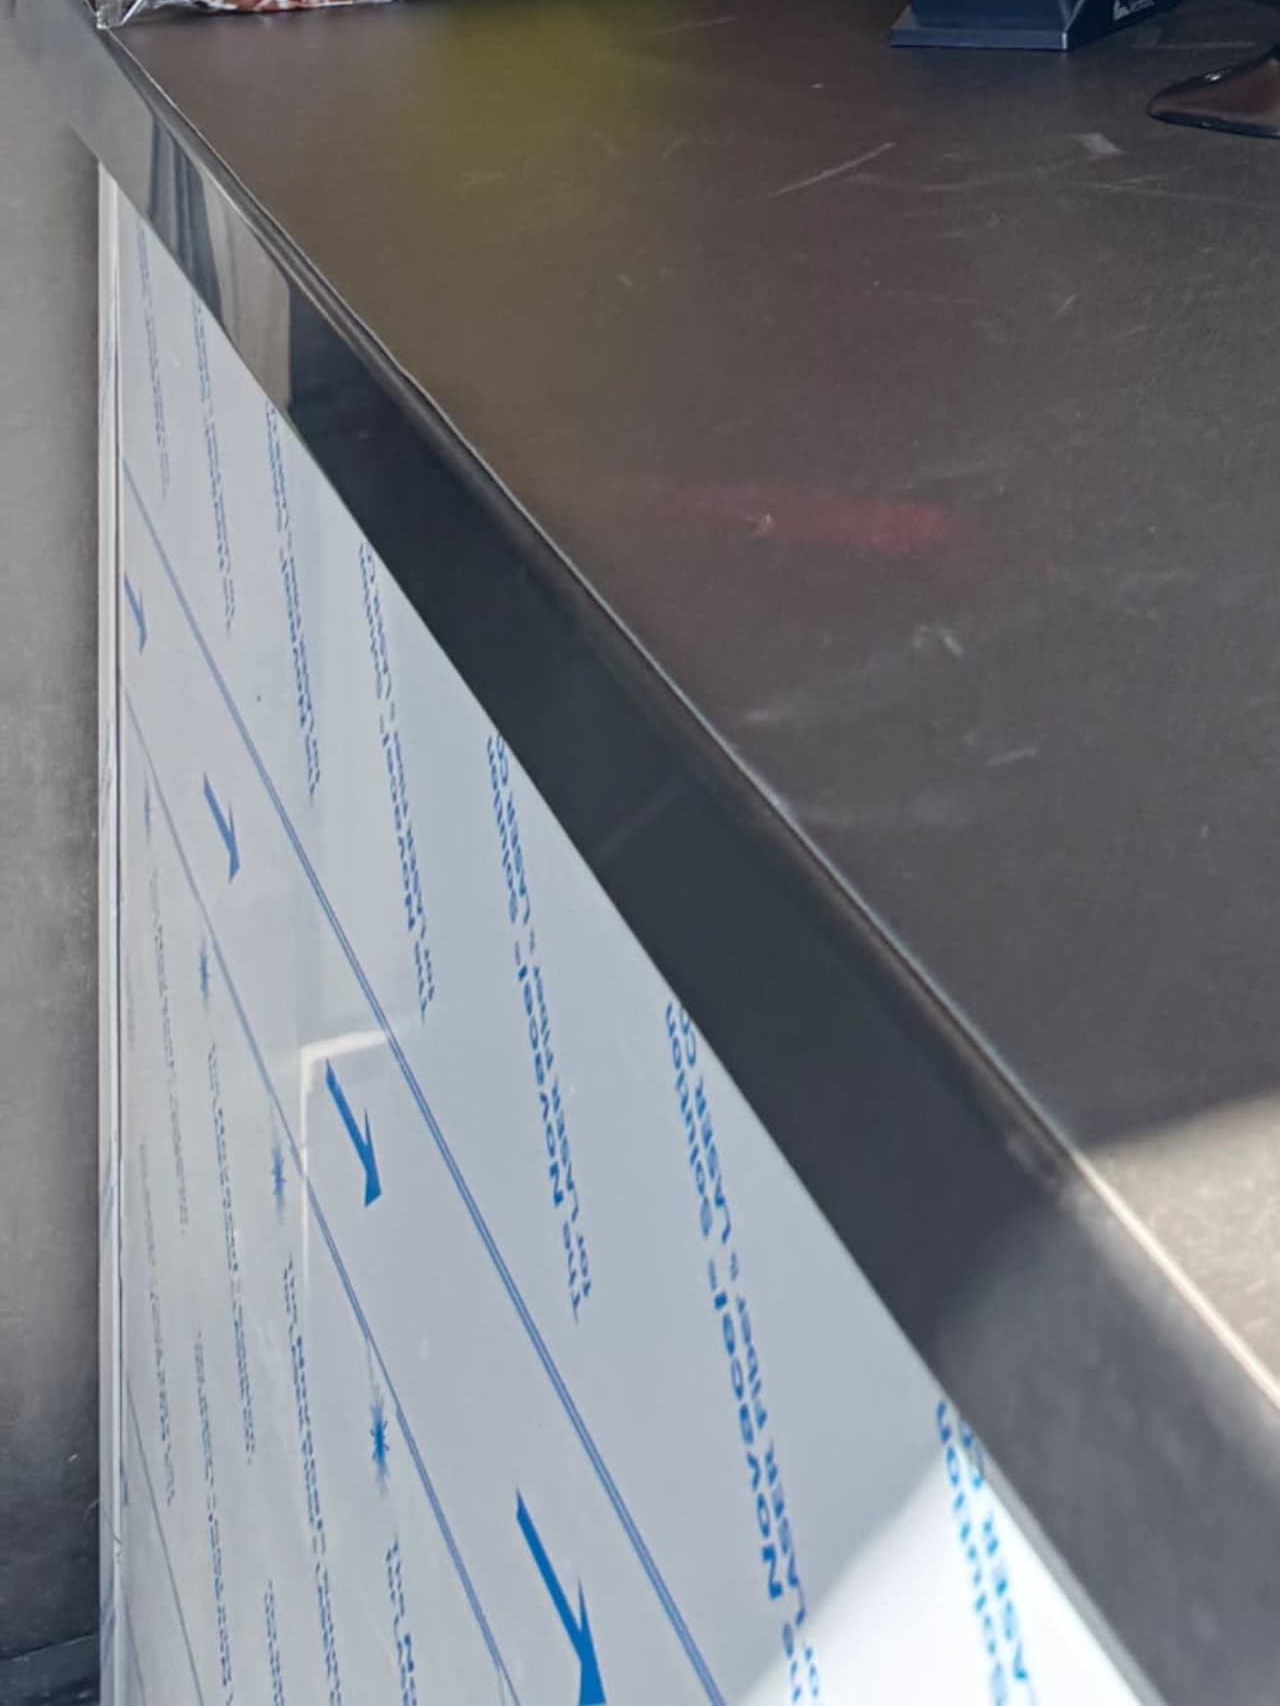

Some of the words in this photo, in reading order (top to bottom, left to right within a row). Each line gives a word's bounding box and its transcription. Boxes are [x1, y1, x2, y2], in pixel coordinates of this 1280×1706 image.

[487, 740, 519, 922] Solution
[501, 796, 528, 923] LASER
[531, 967, 553, 1071] Fiber
[550, 1084, 578, 1221] LASER
[664, 1005, 714, 1236] Solution
[694, 1083, 730, 1243] LASER
[562, 1220, 583, 1313] The
[575, 1236, 592, 1297] for
[736, 1299, 768, 1428] Fiber
[755, 1418, 804, 1626] LASER
[782, 1616, 802, 1704] he
[802, 1647, 819, 1698] or
